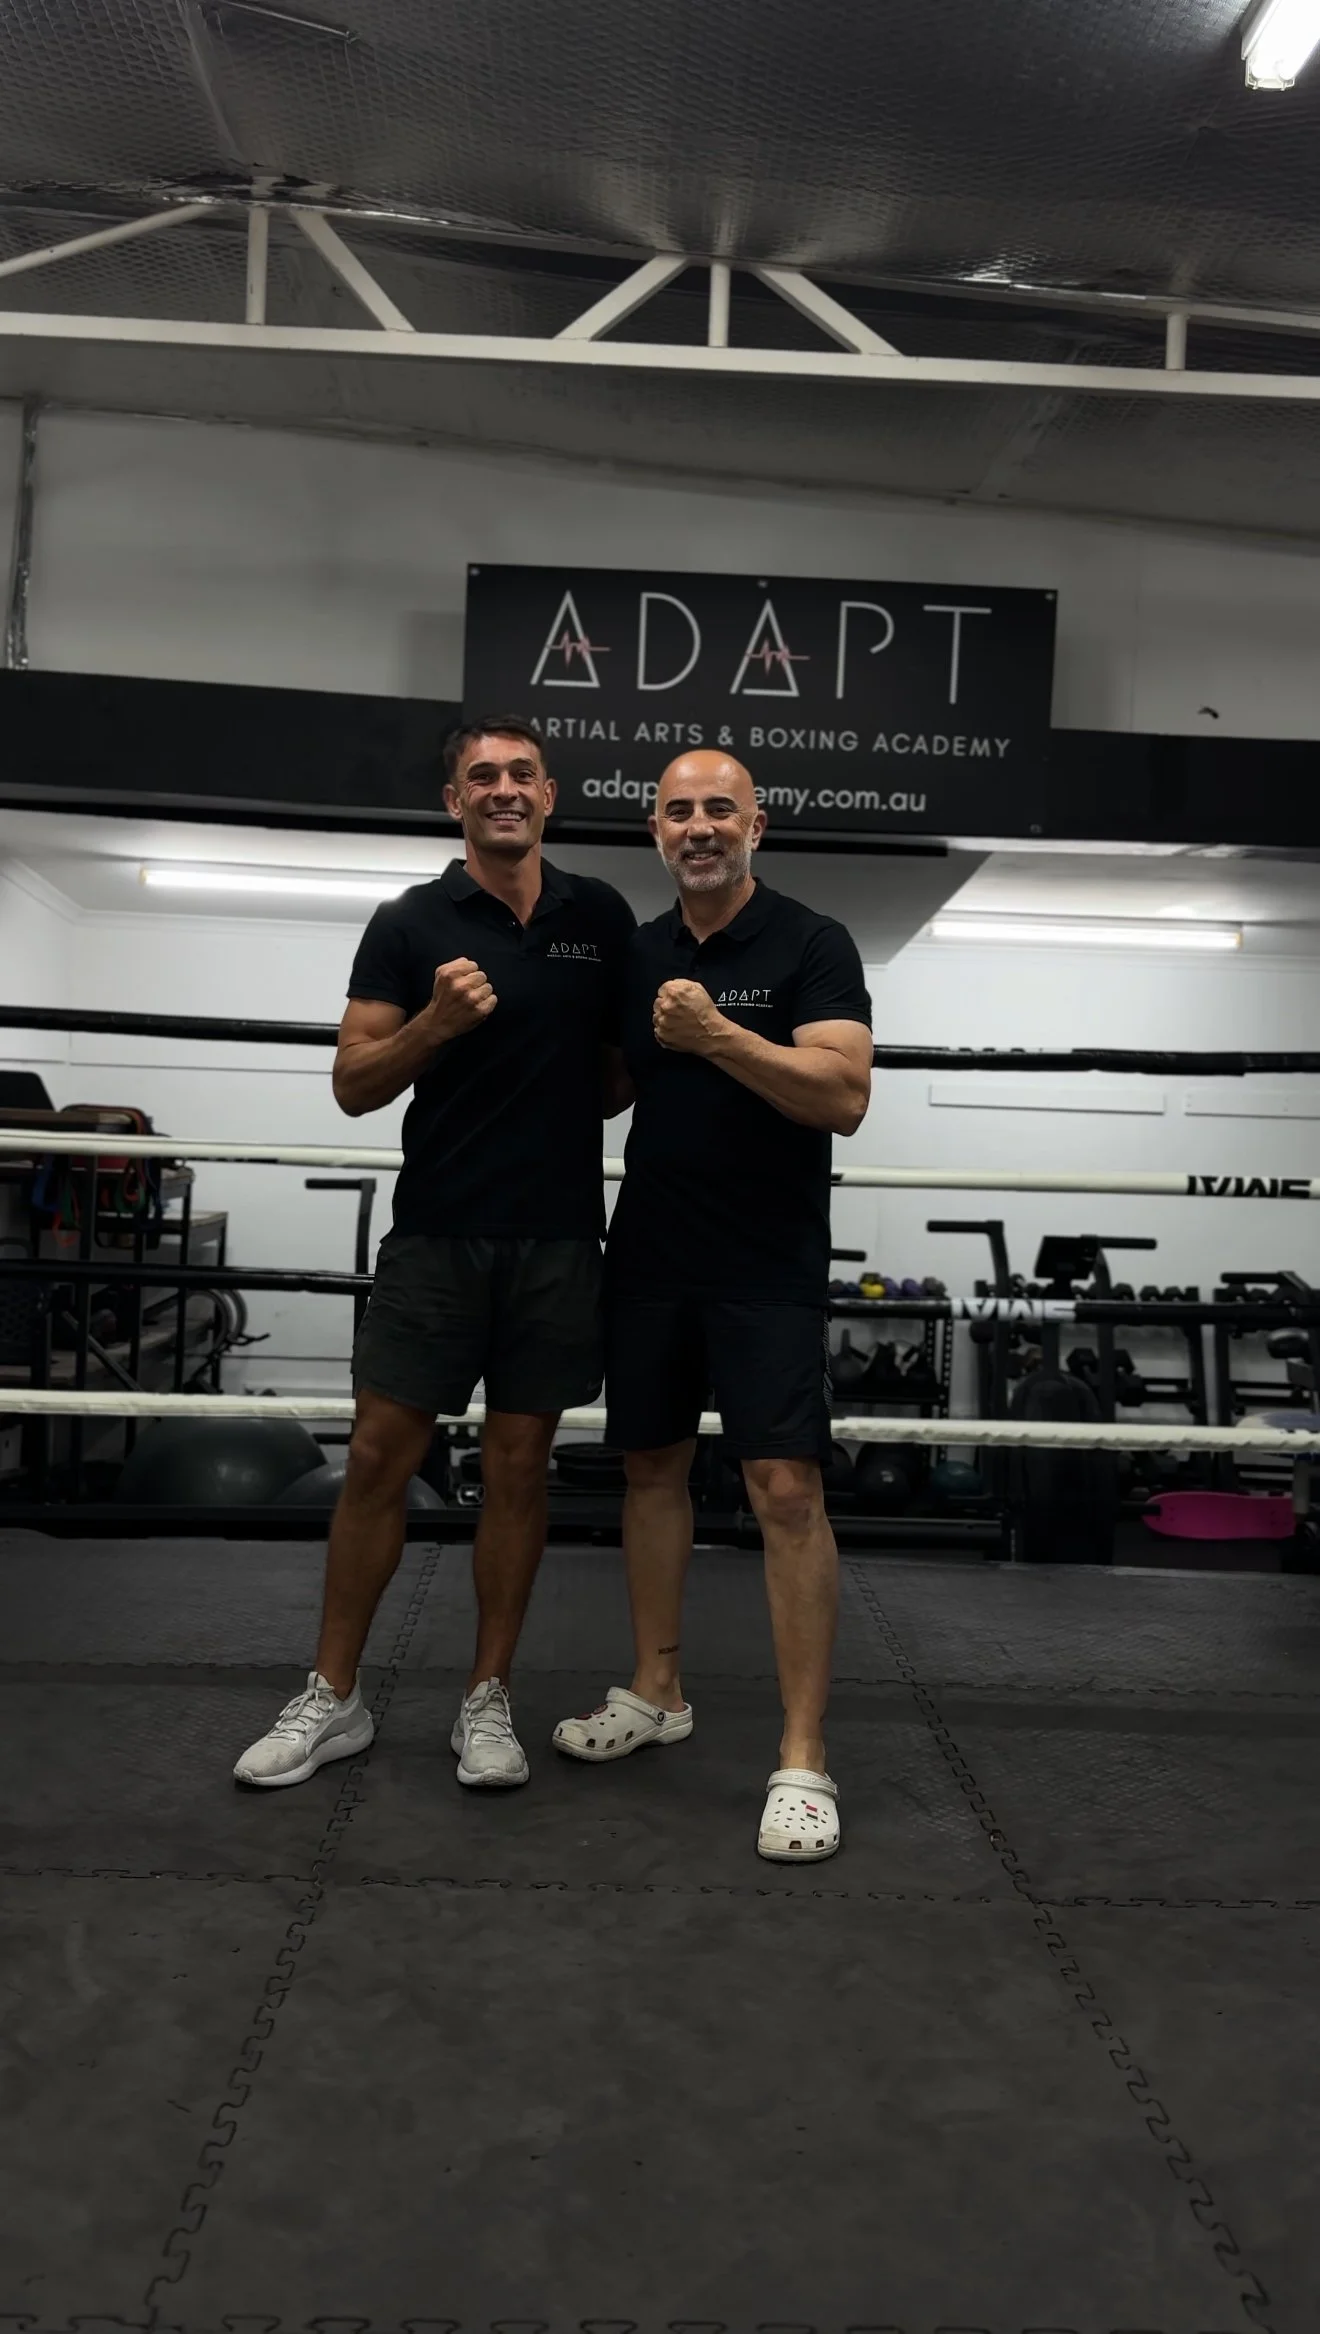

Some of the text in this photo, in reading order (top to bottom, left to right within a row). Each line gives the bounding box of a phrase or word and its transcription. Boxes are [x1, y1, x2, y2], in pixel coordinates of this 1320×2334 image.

[530, 590, 992, 704] ADAPT
[530, 717, 1011, 758] ARTIAL ARTS & BOXING ACADEMY
[582, 769, 927, 815] adapemy.com.au
[550, 942, 598, 957] ADAPT
[718, 989, 772, 1002] ADAPT
